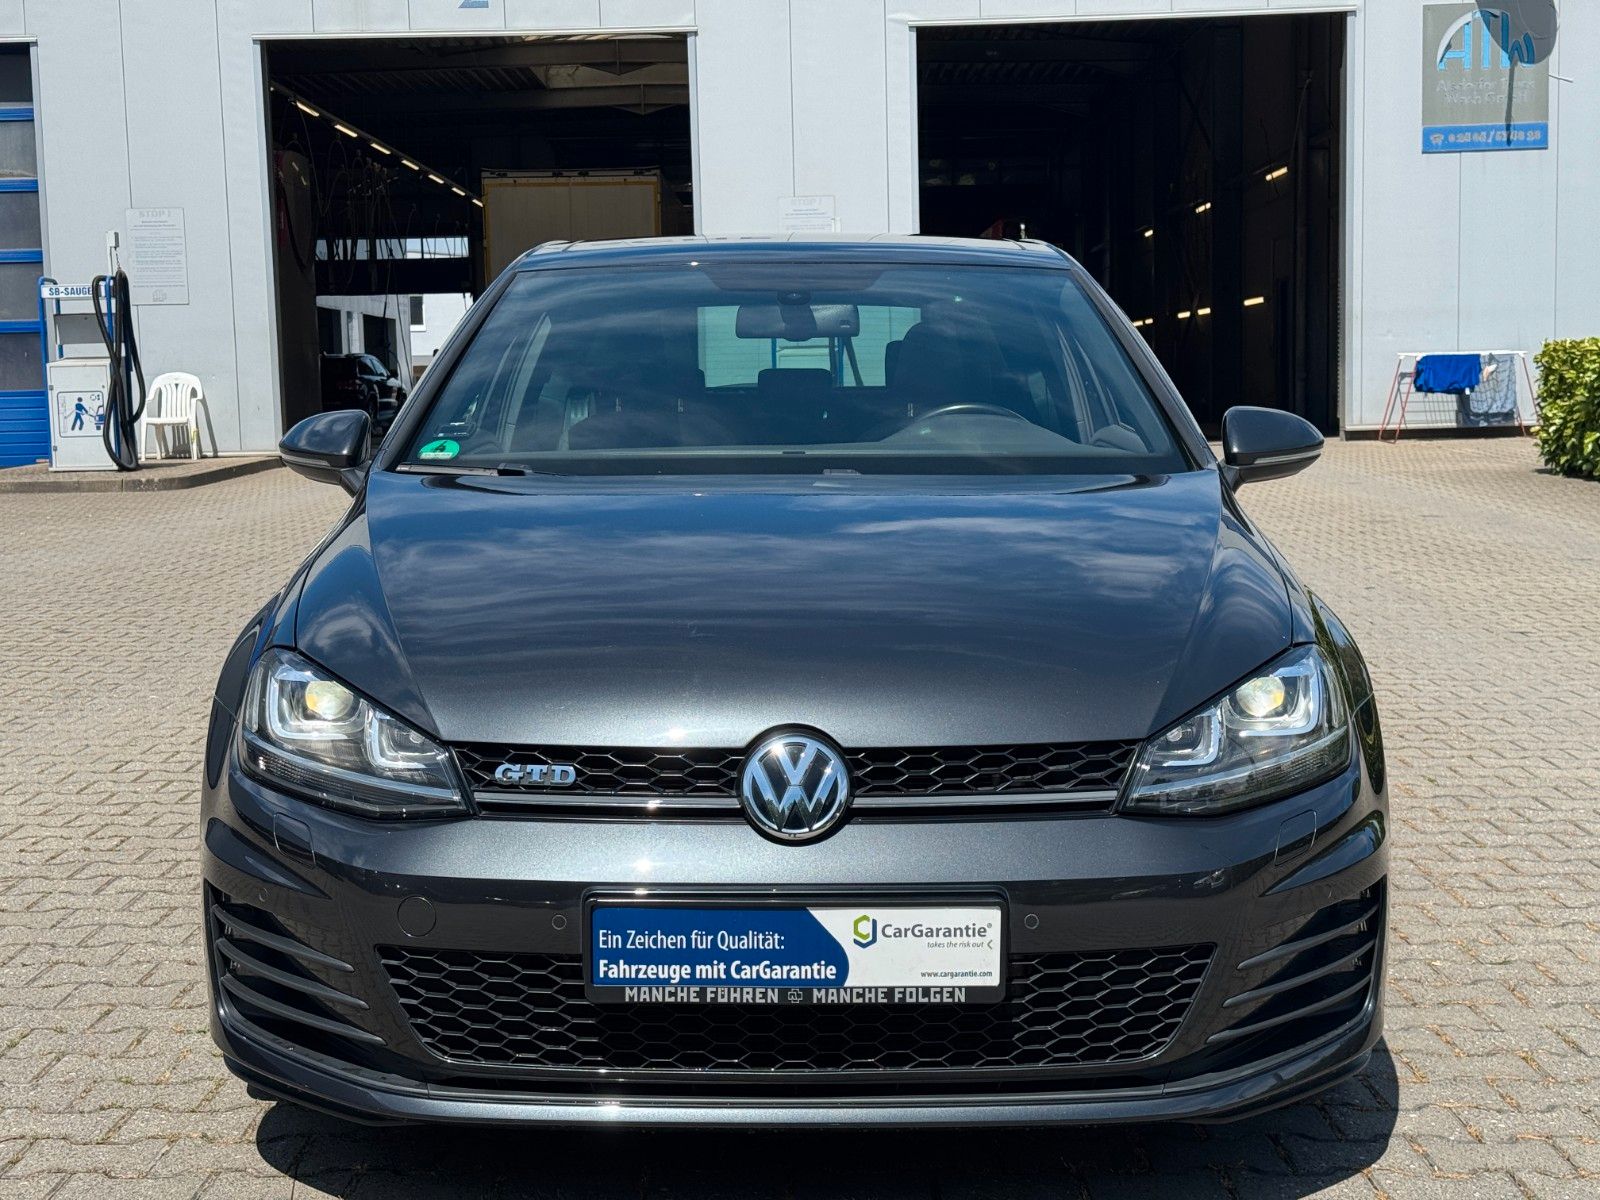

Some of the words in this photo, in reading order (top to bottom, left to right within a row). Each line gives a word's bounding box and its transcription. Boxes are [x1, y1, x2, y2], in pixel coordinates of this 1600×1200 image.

[49, 286, 93, 297] SB-SAUGE
[494, 764, 576, 786] GTD
[599, 929, 622, 949] Ein
[626, 929, 687, 949] Zeichen
[691, 929, 714, 949] für
[717, 930, 785, 951] Qualität:
[927, 941, 946, 949] takes
[947, 941, 958, 949] the
[958, 941, 972, 949] risk
[599, 959, 691, 984] Fahrzeuge
[695, 960, 727, 979] mit
[730, 960, 837, 979] CarGarantie
[920, 970, 993, 980] www.cargarantie.com
[625, 986, 700, 1003] MANCHE
[706, 987, 779, 1004] FÜHREN
[812, 987, 888, 1004] MANCHE
[894, 987, 966, 1004] FOLGEN
